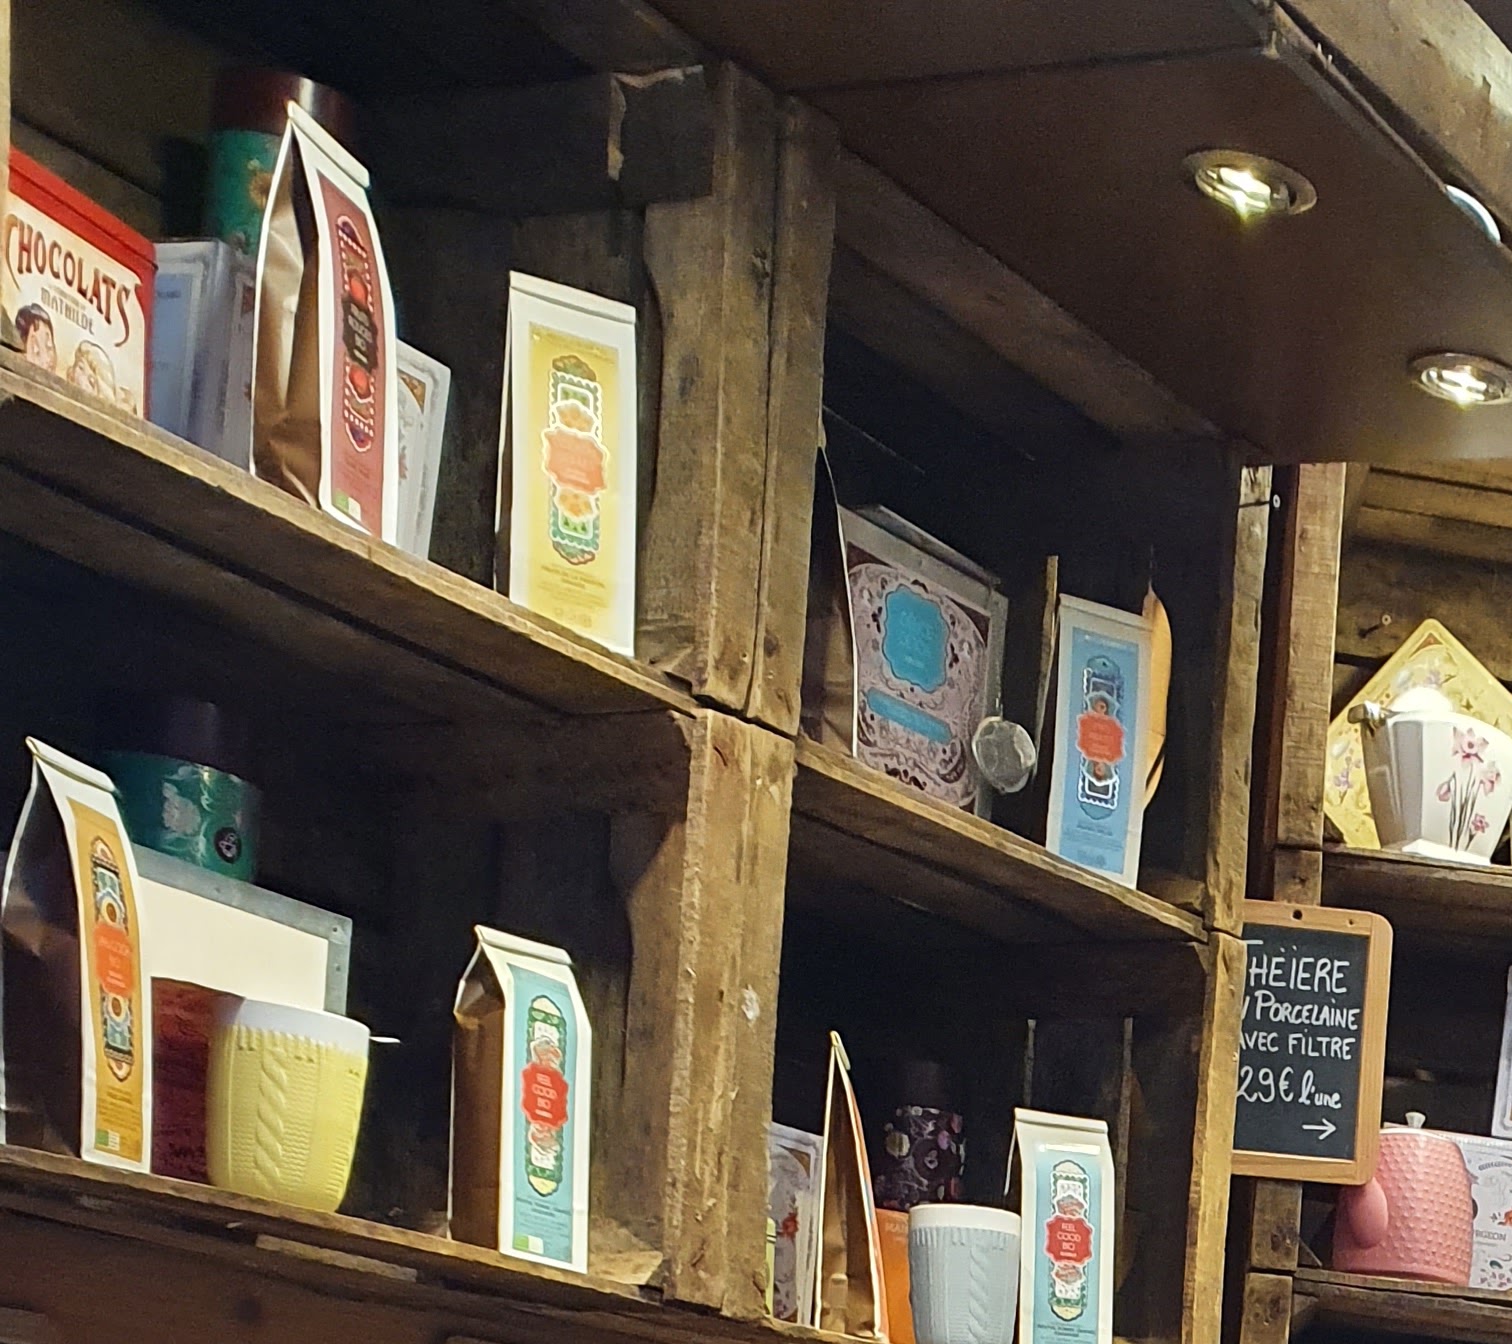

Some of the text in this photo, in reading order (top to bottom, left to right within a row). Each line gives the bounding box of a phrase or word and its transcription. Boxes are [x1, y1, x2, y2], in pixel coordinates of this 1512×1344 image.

[5, 214, 130, 347] CHOCOLATS
[1288, 1028, 1356, 1060] FILTRE
[1236, 1066, 1294, 1103] 29€
